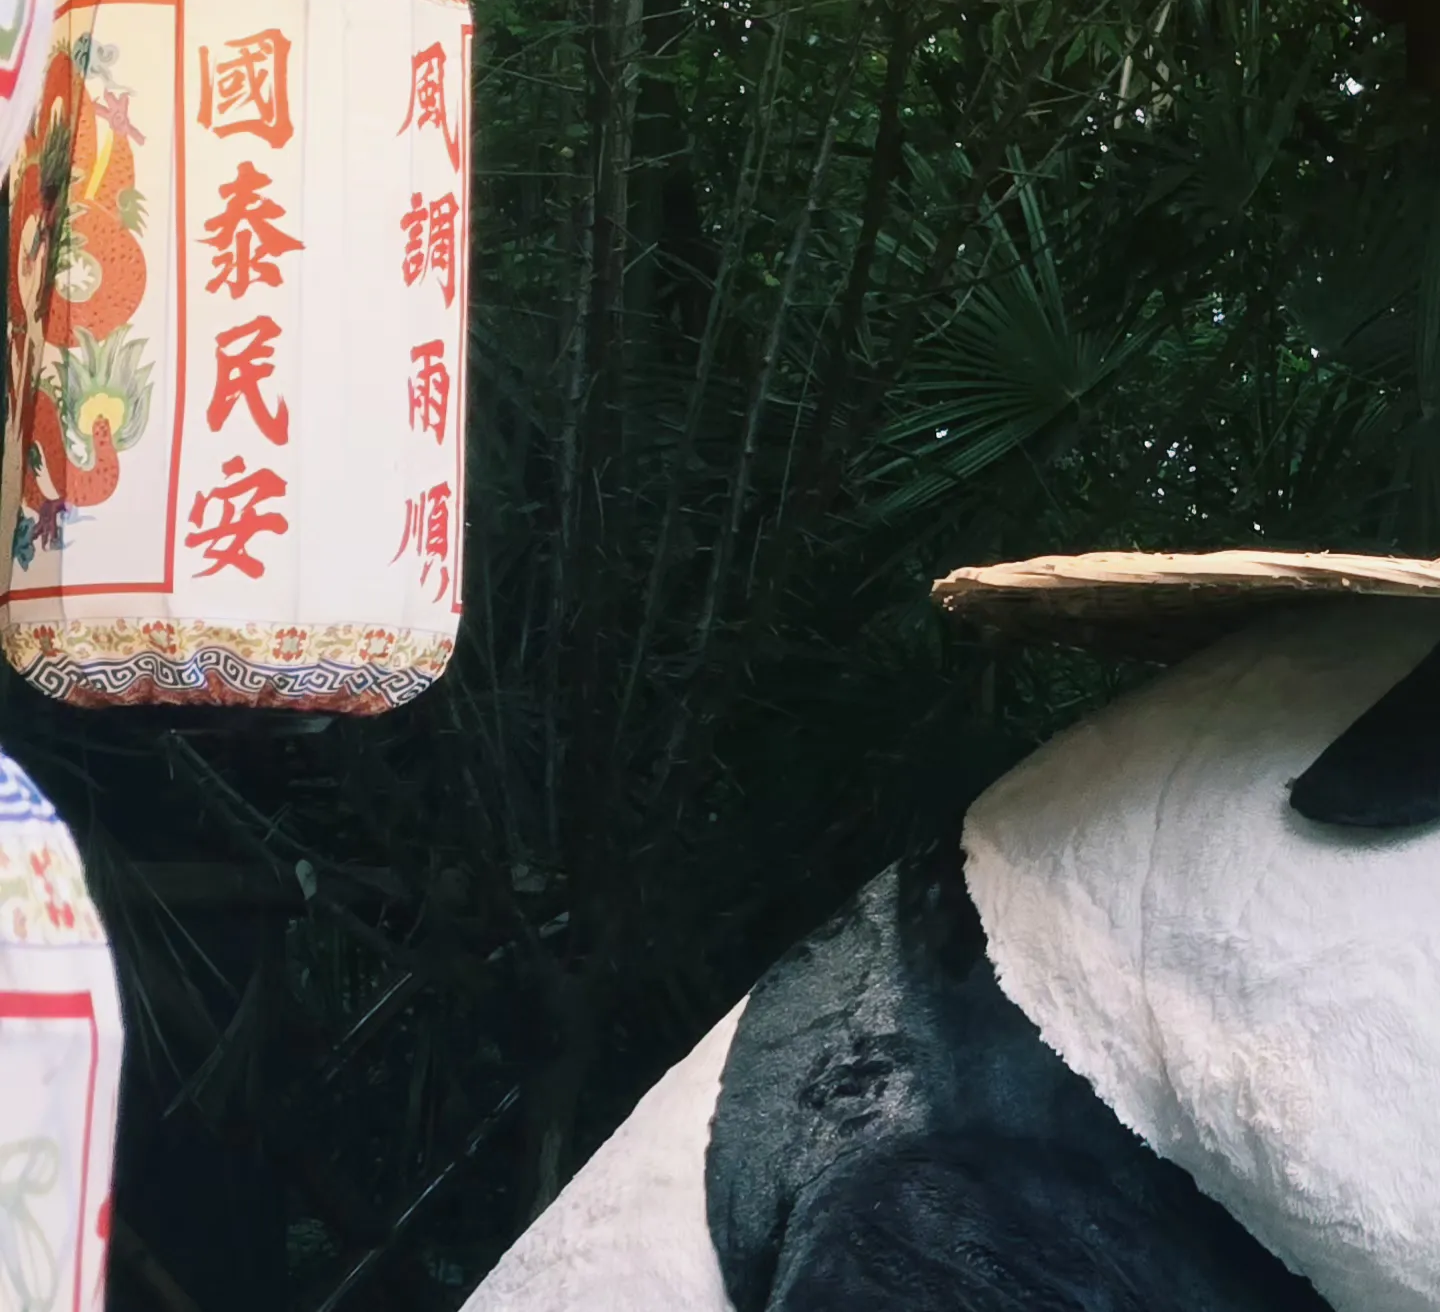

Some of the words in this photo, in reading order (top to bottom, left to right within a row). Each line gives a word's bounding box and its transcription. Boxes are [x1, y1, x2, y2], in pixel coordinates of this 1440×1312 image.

[184, 28, 306, 579] 國泰民安
[390, 41, 460, 604] 風調雨順
